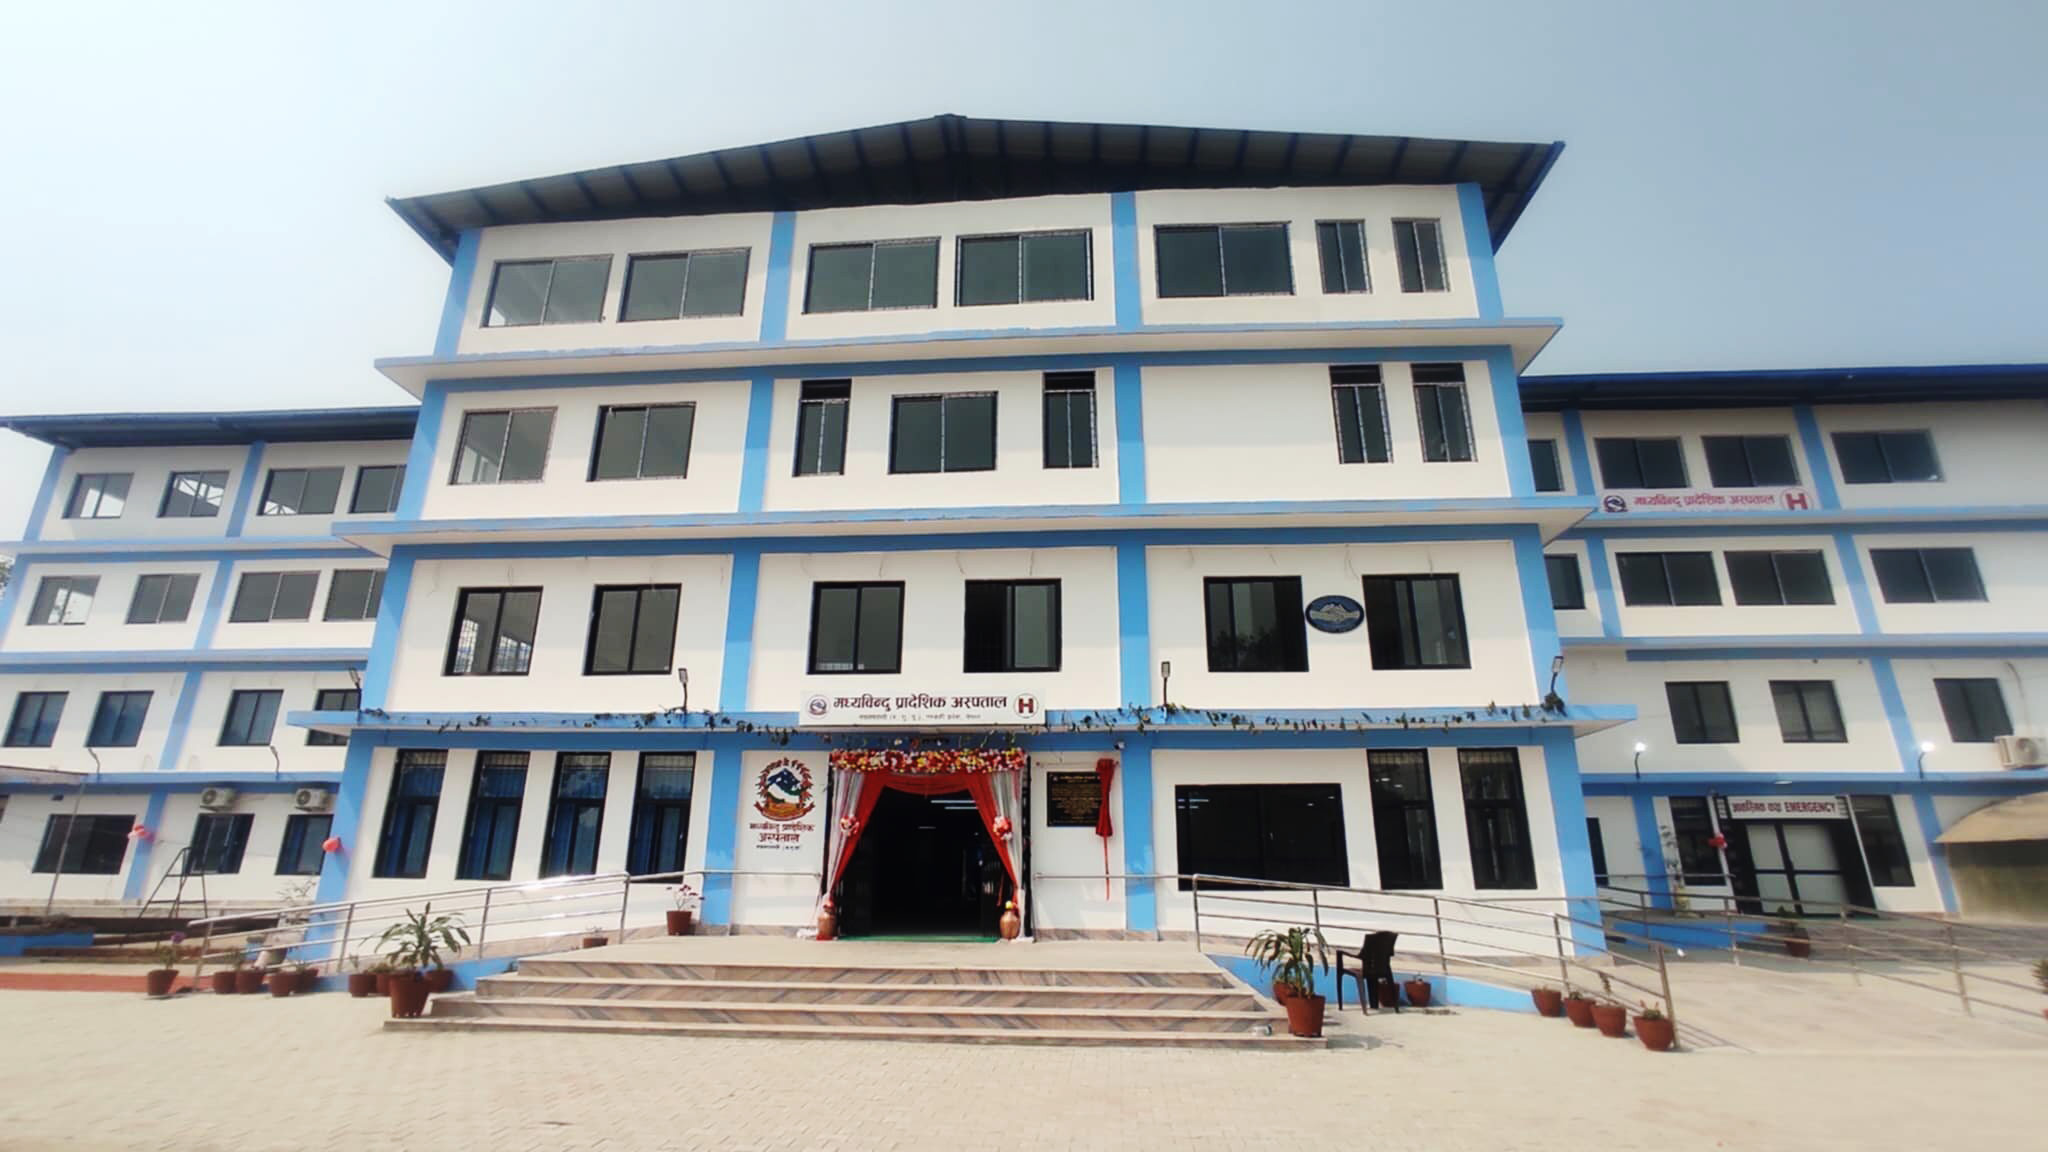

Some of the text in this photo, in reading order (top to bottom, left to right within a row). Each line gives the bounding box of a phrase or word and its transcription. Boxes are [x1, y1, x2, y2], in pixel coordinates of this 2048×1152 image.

[1786, 493, 1808, 511] H
[895, 693, 946, 709] प्रादेशिक
[951, 695, 1007, 708] अस्पताल
[1018, 698, 1034, 713] H
[1784, 801, 1835, 813] EMERGENCY
